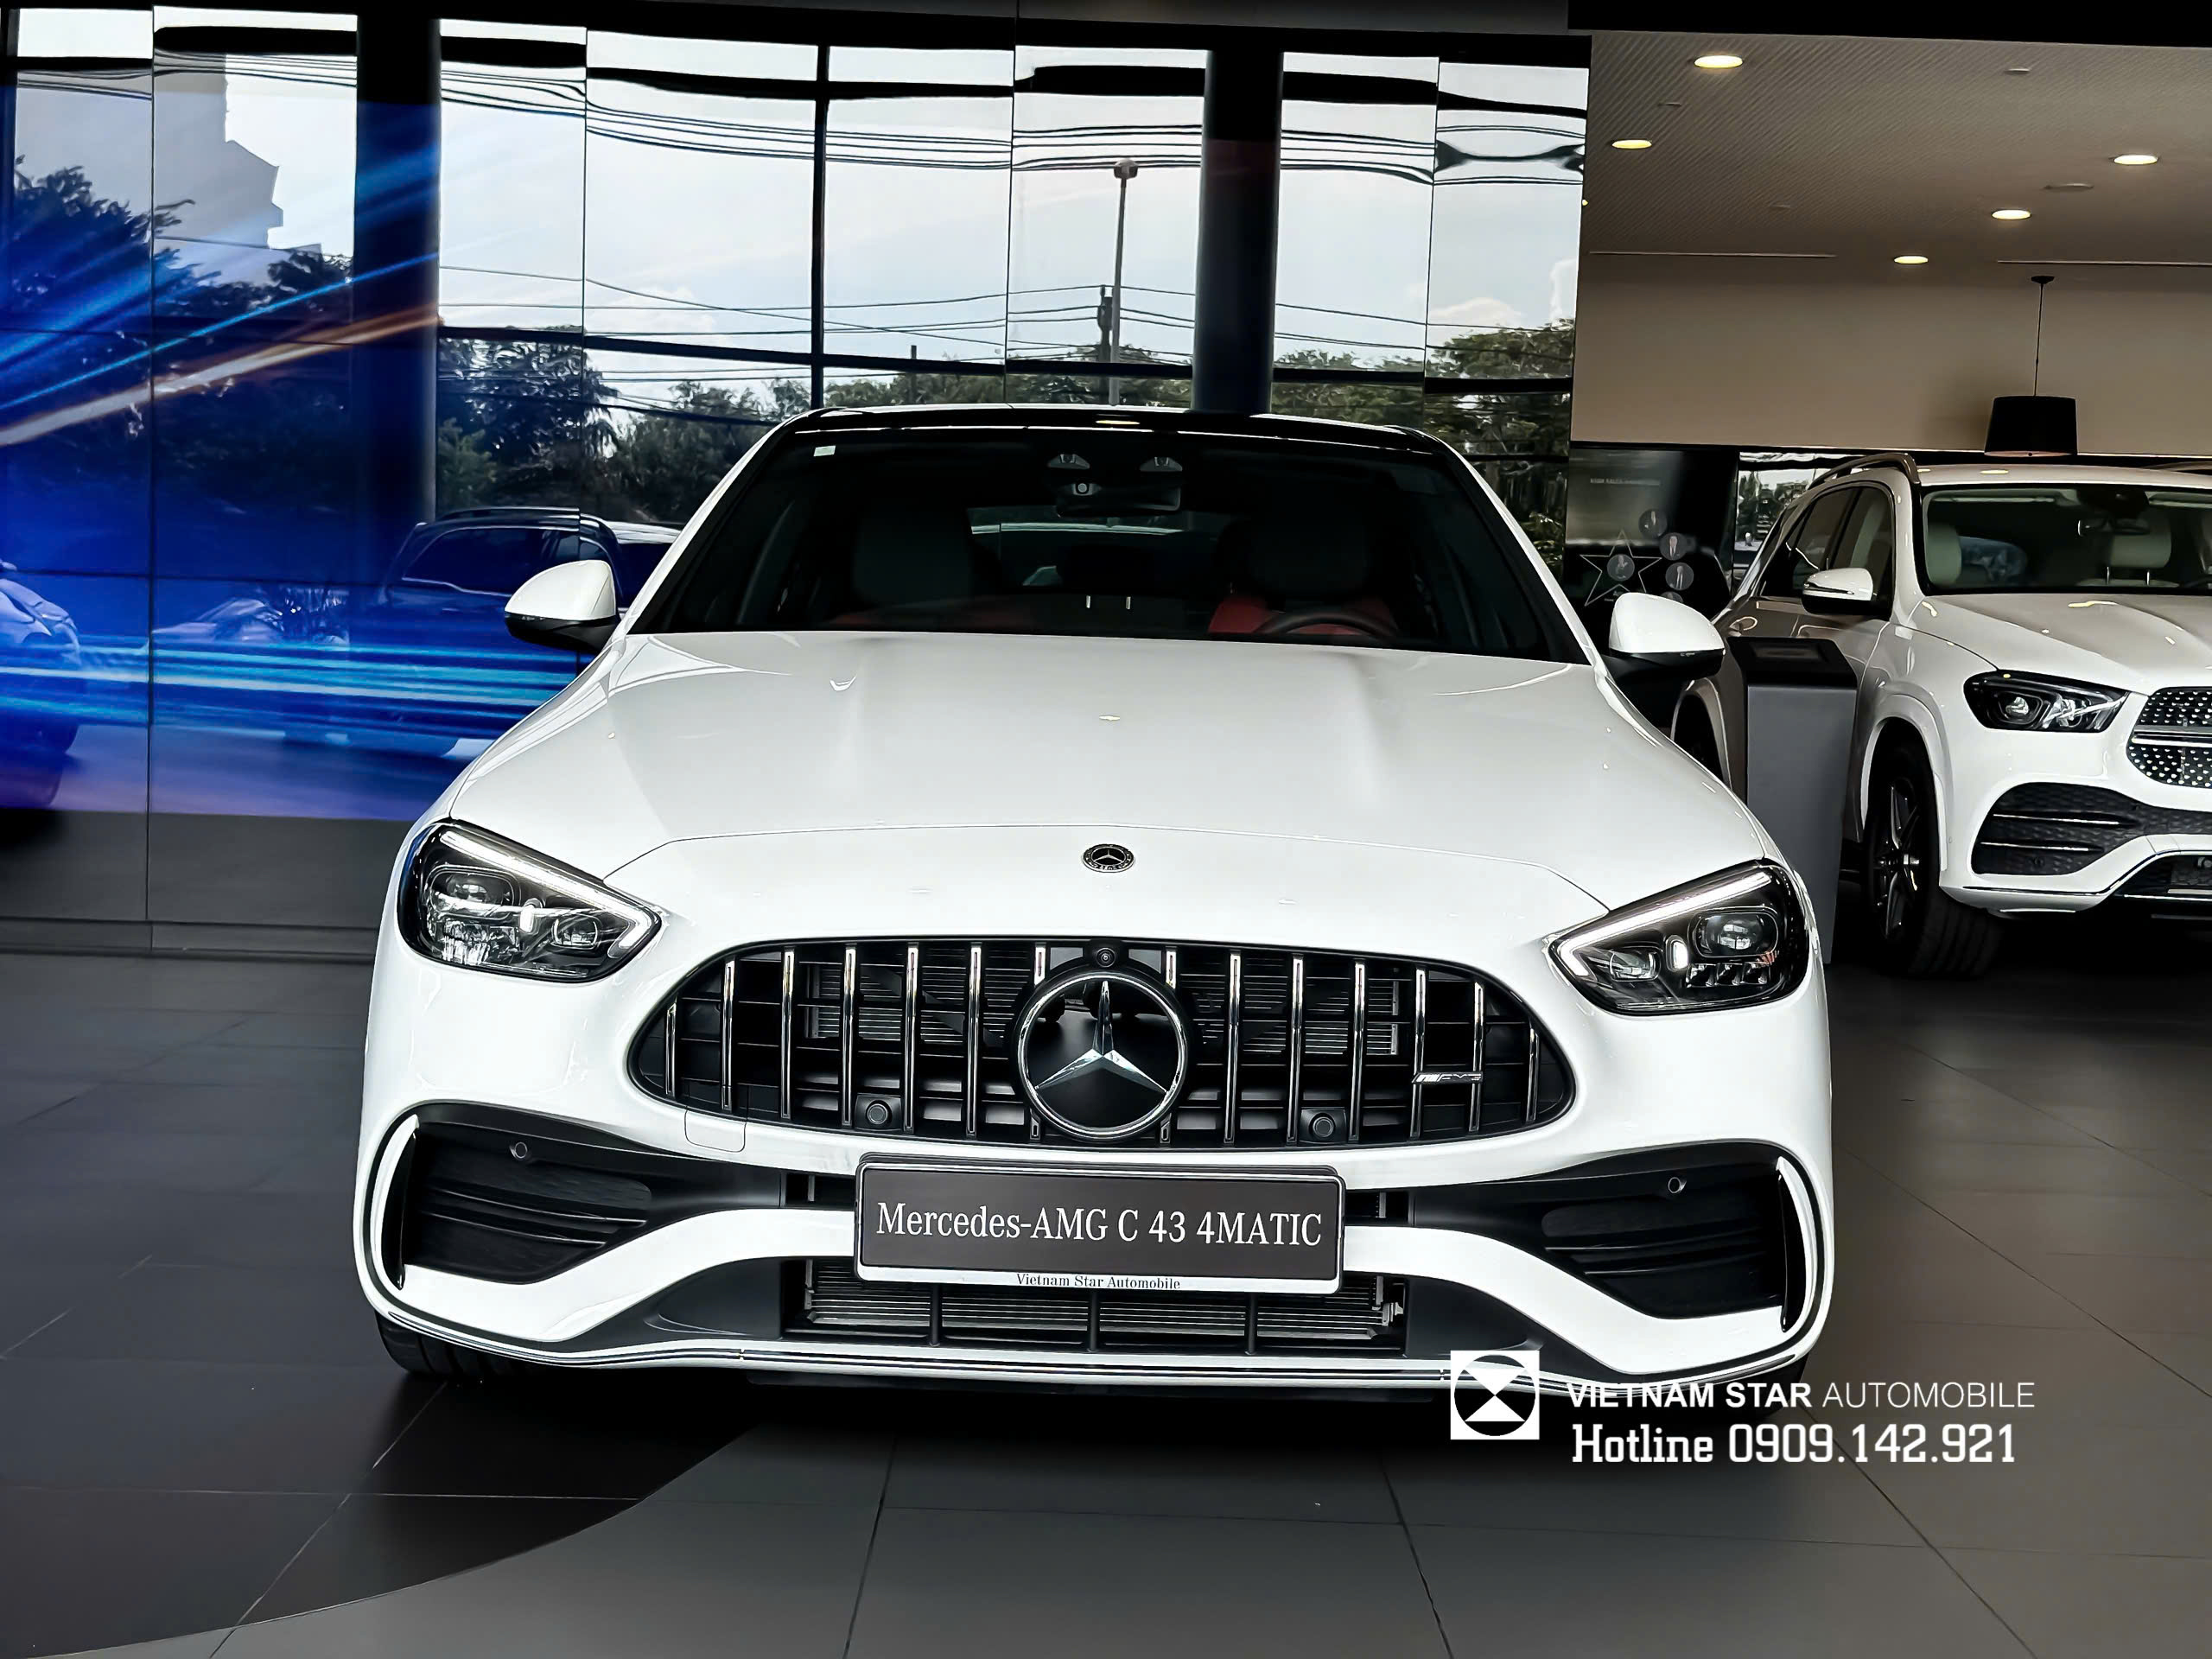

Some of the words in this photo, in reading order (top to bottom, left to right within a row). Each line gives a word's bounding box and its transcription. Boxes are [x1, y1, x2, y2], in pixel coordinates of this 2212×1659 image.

[876, 1202, 1108, 1241] Mercedes-AMG
[1117, 1209, 1138, 1243] C
[1148, 1210, 1185, 1243] 43
[1196, 1211, 1322, 1246] 4MATIC
[1016, 1273, 1071, 1288] Vietnam
[1074, 1274, 1104, 1288] Star
[1107, 1275, 1181, 1290] Automobile
